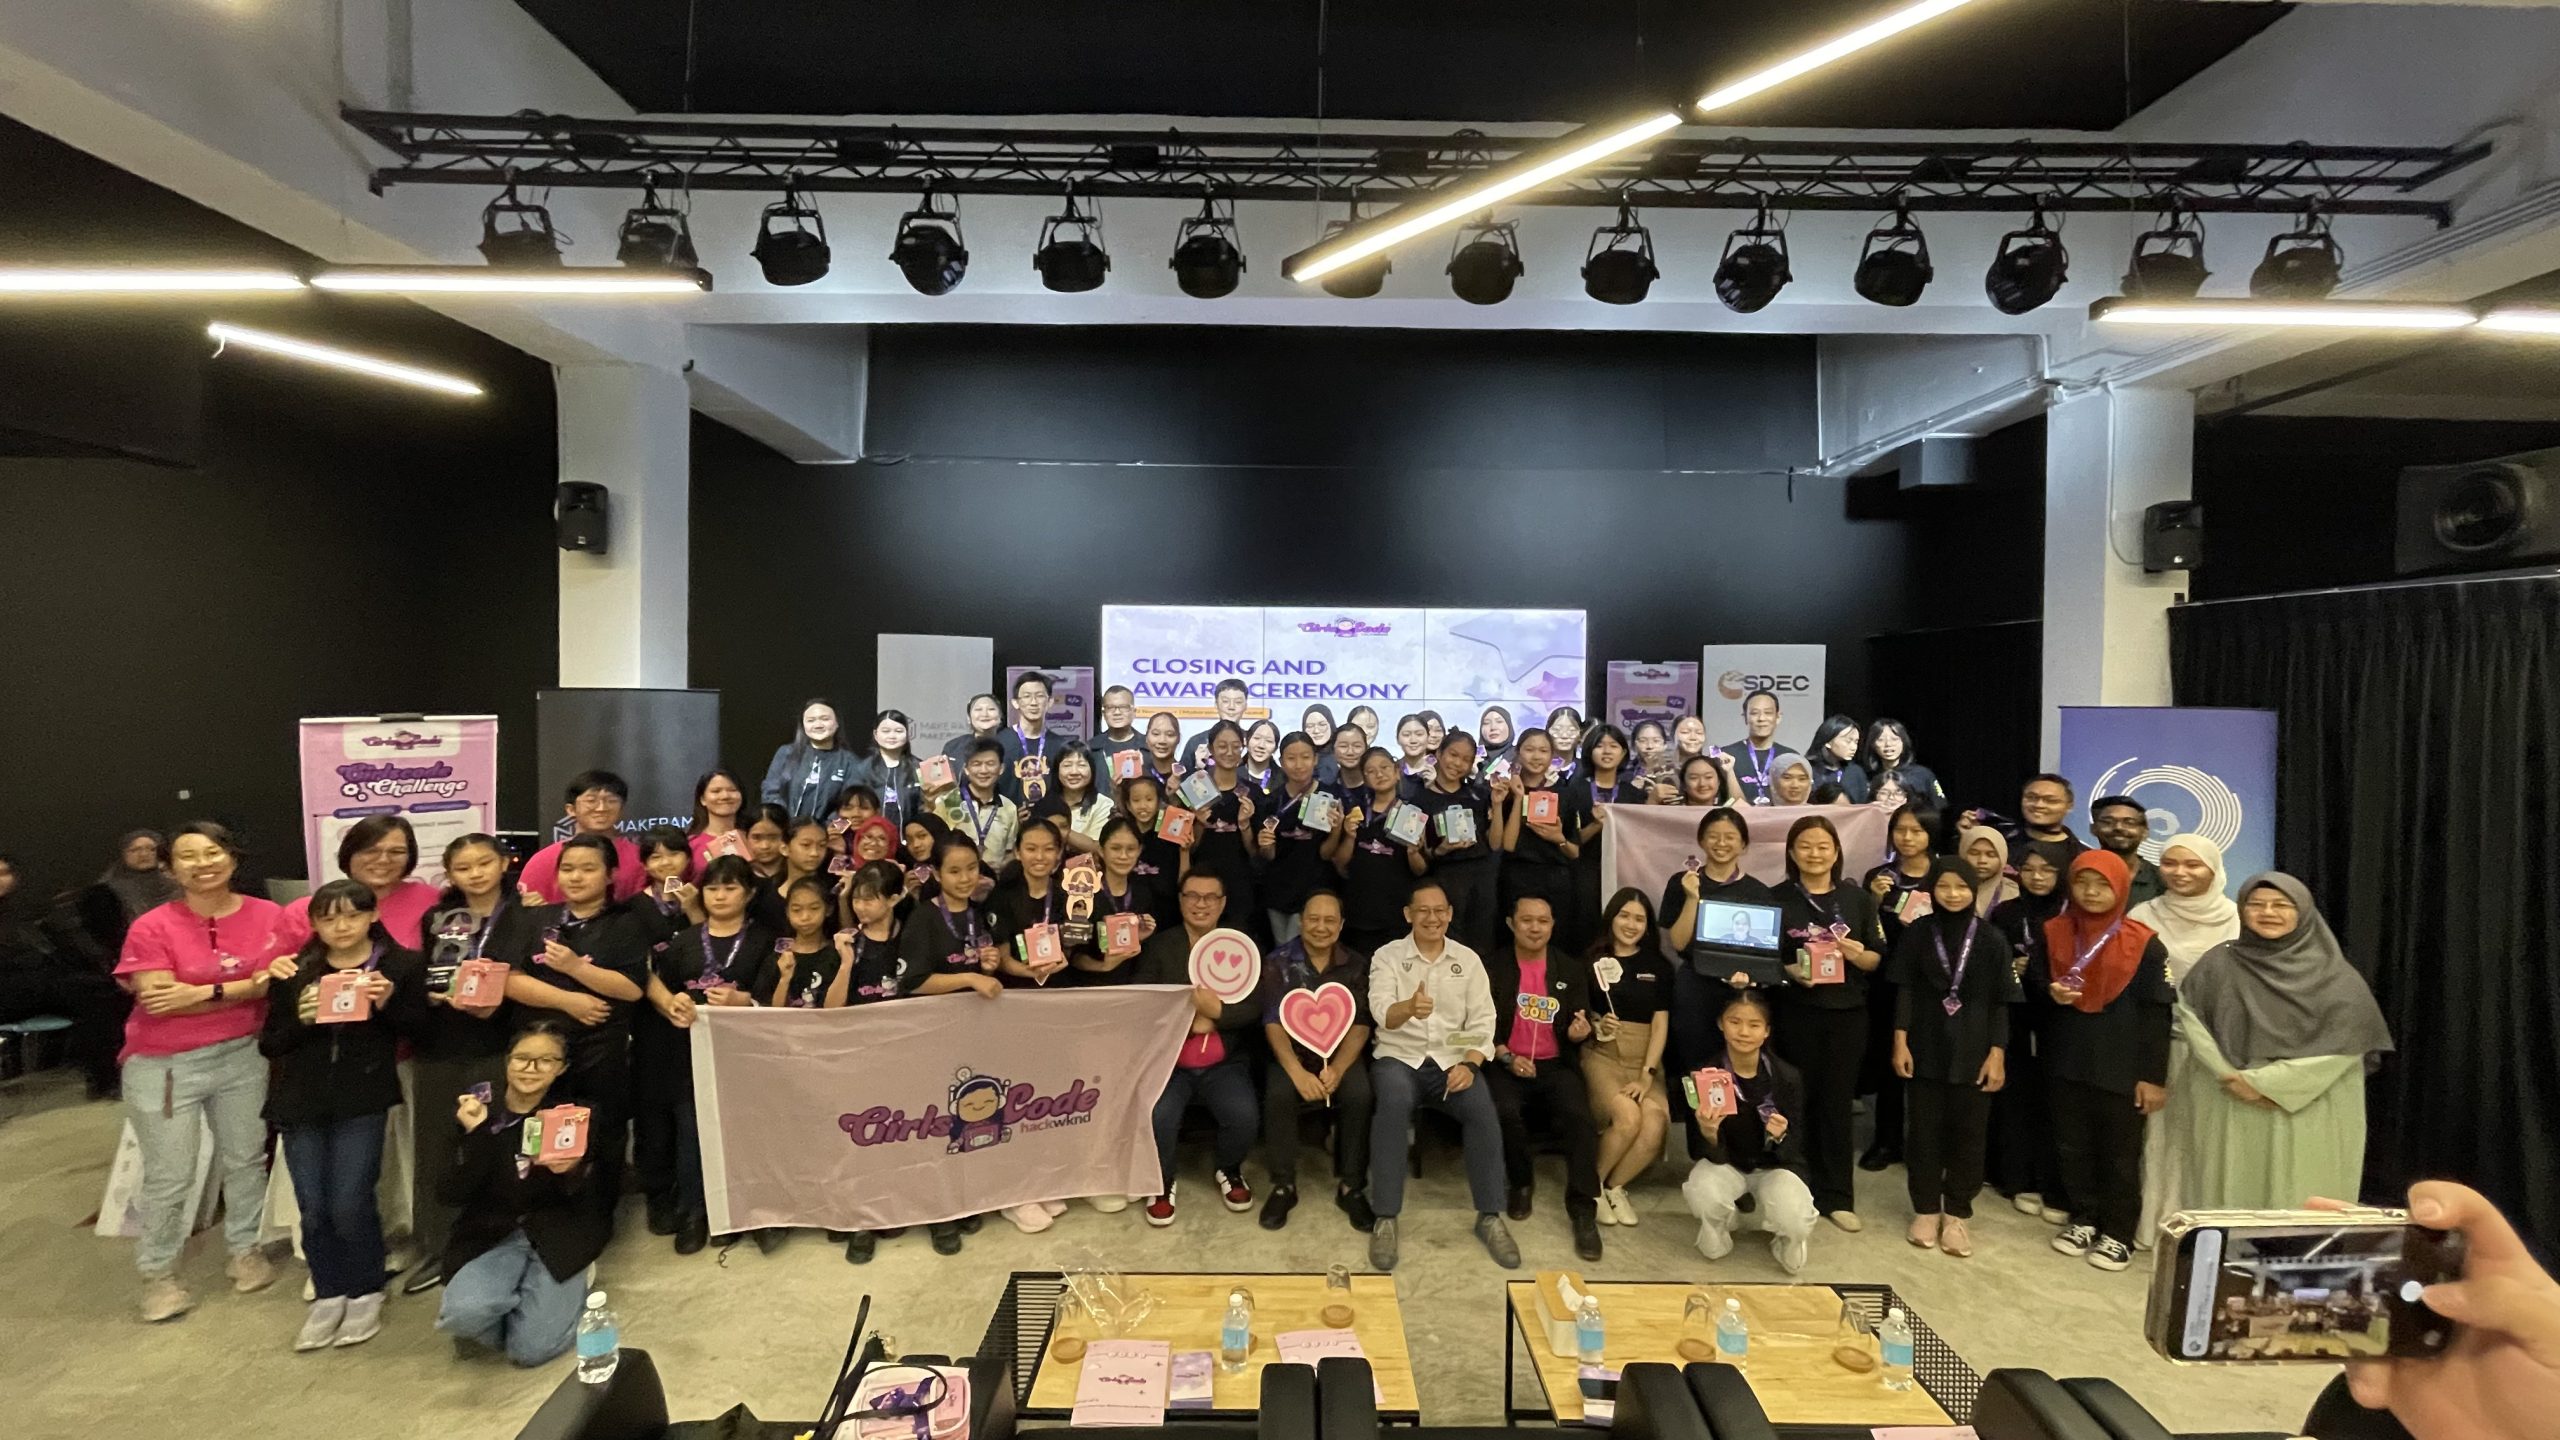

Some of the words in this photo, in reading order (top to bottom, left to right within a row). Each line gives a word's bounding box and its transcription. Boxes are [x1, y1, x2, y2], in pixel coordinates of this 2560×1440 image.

[1132, 658, 1256, 675] CLOSING
[1263, 660, 1326, 675] AND
[1134, 681, 1215, 697] AWAR
[1250, 683, 1409, 699] CEREMONY
[1743, 675, 1809, 691] SDEC
[367, 779, 468, 798] Challenge
[1518, 994, 1558, 1010] GOOD
[838, 1104, 953, 1146] Girls
[1001, 1078, 1100, 1125] Code
[1020, 1111, 1091, 1133] hackwknd
